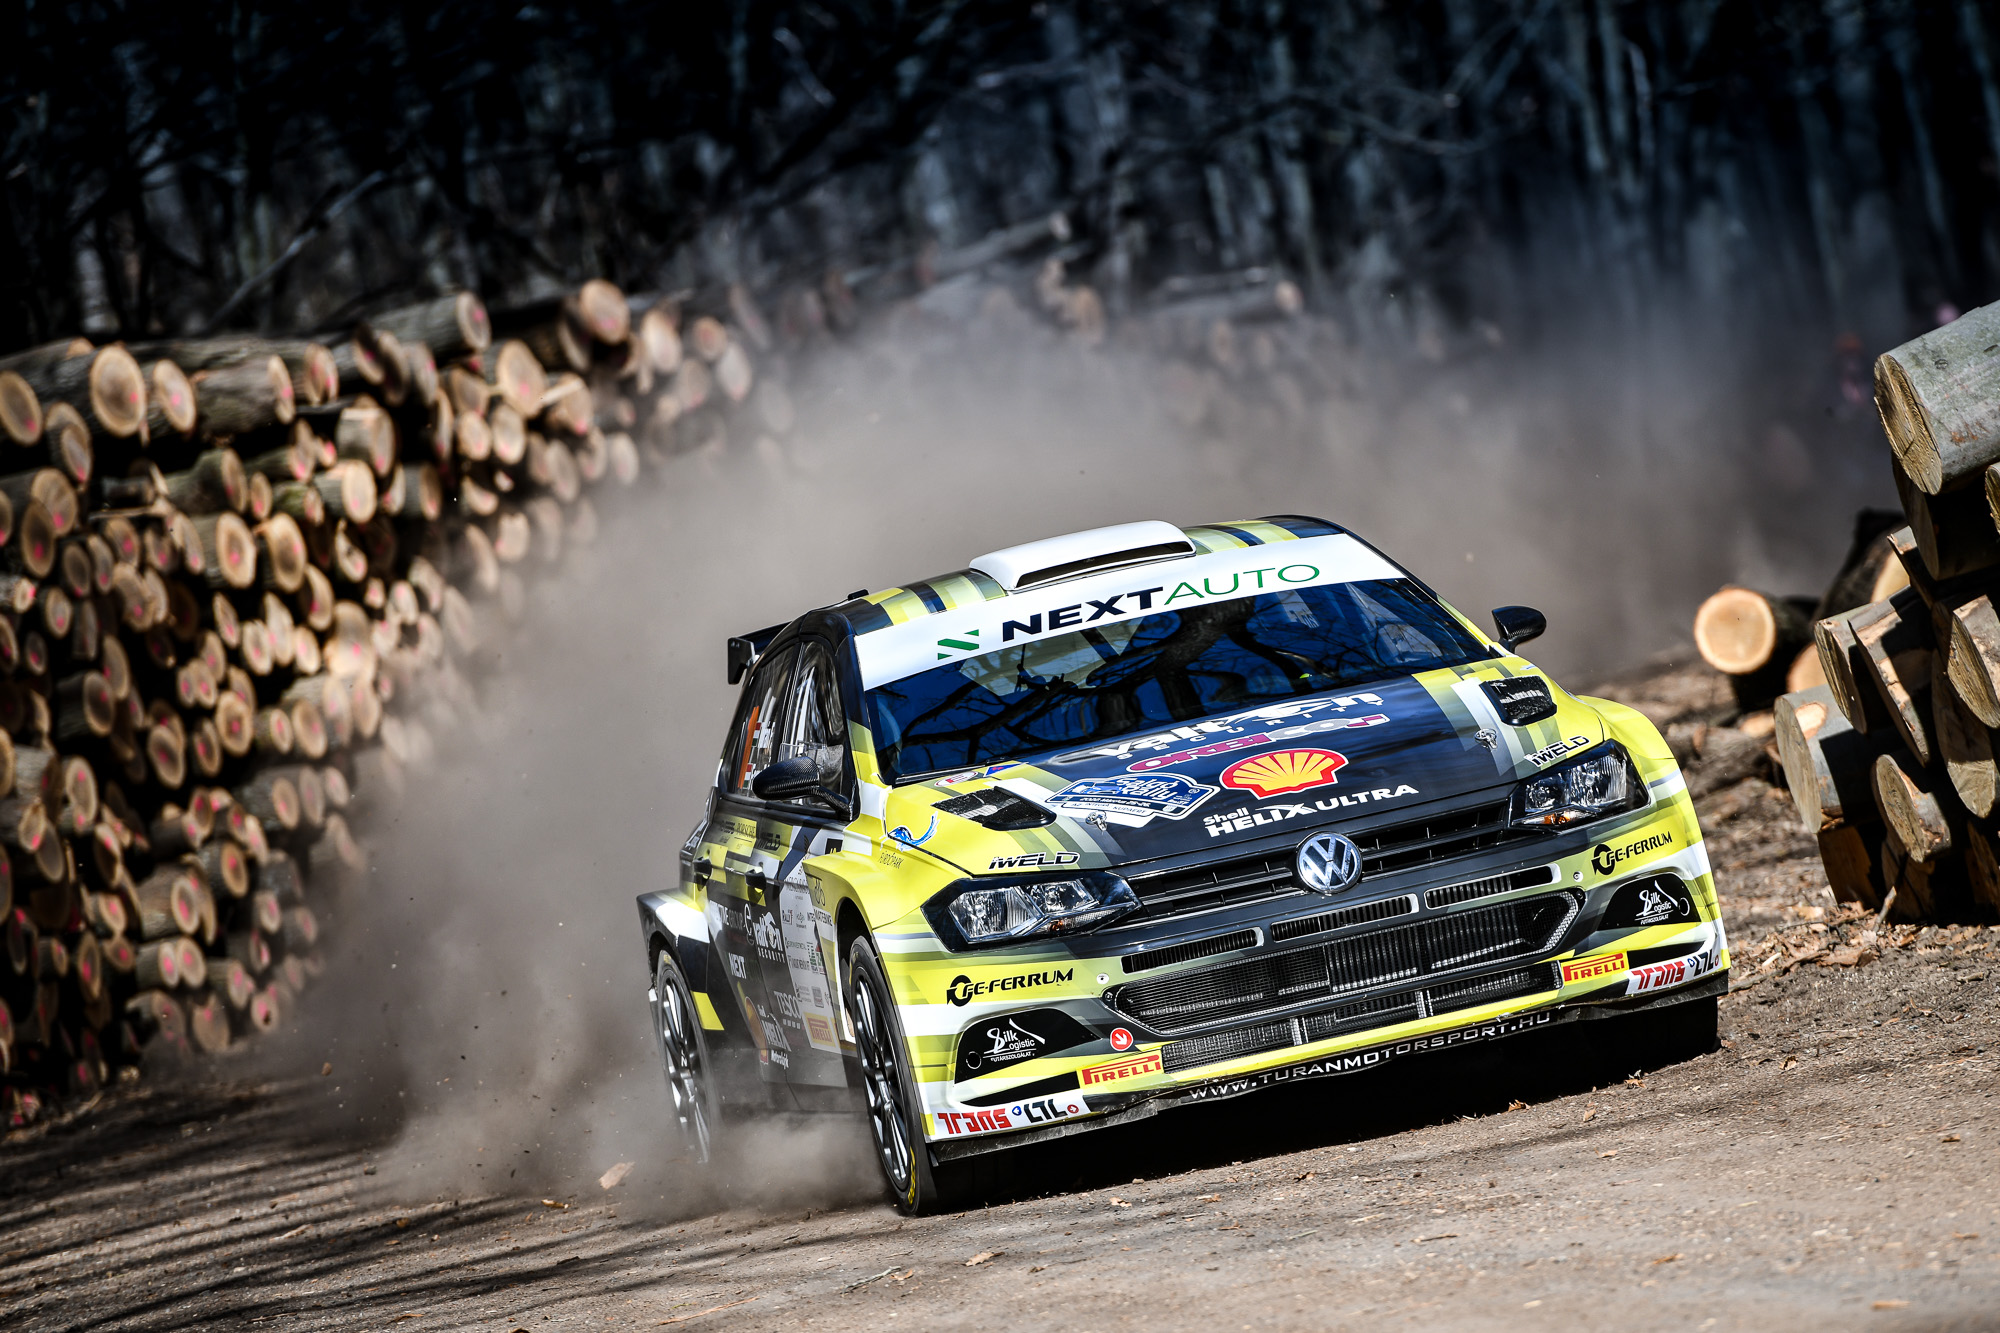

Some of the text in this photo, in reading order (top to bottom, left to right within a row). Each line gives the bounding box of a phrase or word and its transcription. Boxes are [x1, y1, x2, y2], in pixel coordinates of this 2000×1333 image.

[1002, 564, 1320, 642] NEXTAUTO
[1315, 784, 1419, 811] ULTRA
[1203, 807, 1249, 826] Shell
[1204, 803, 1317, 838] HELIX
[1562, 953, 1625, 982] PIRELLI
[773, 991, 802, 1019] TESCO
[807, 1017, 833, 1043] PIRELLI
[1082, 1054, 1161, 1085] PIRELLI
